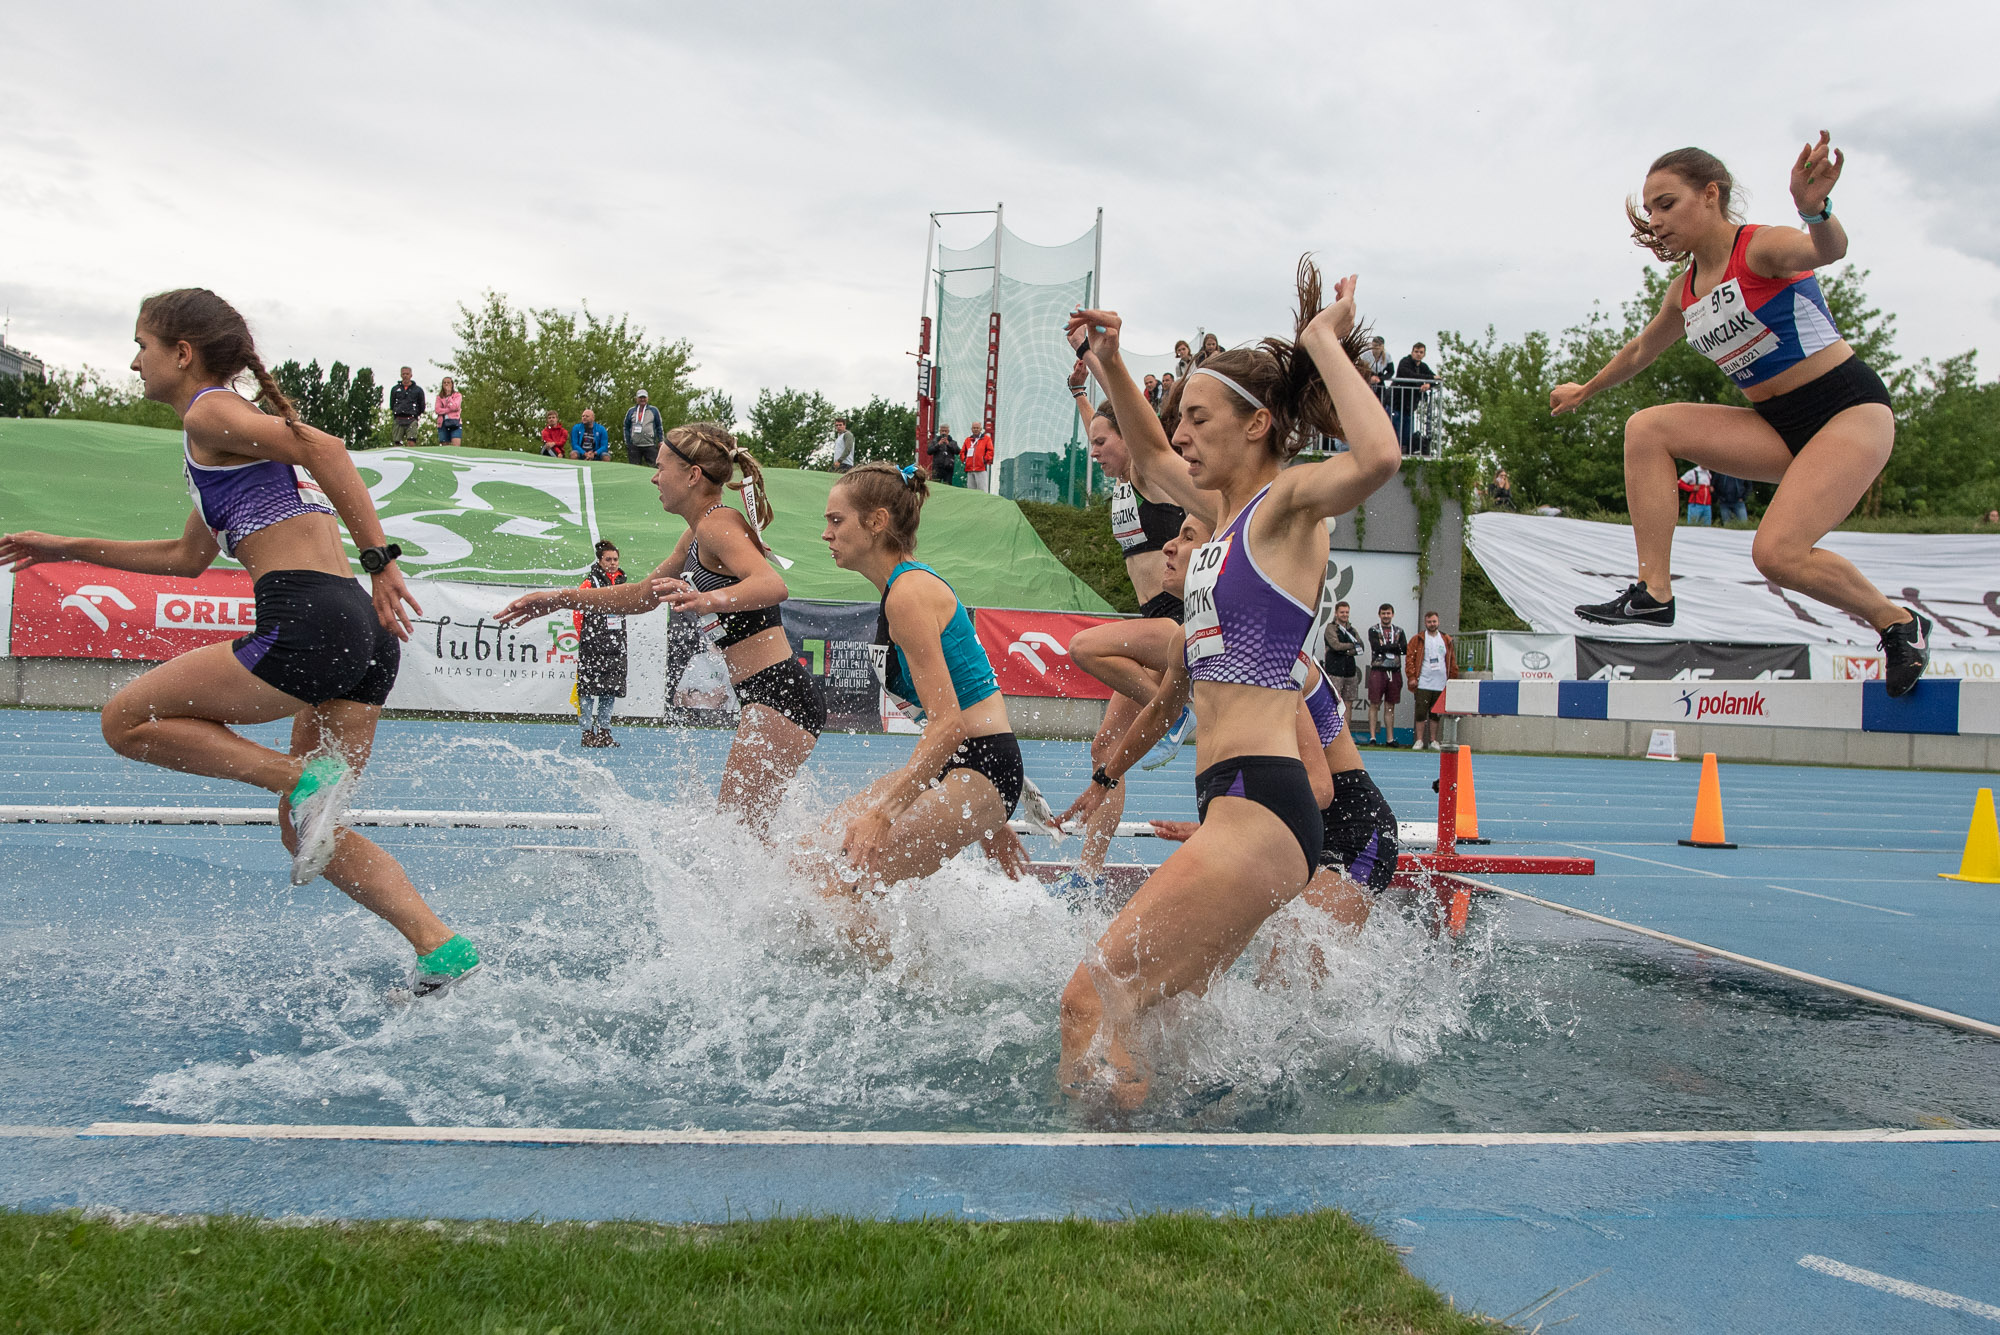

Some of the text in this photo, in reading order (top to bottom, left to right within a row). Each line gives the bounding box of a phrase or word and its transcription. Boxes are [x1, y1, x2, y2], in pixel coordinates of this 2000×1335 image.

[1690, 311, 1755, 355] KLIMCZAK
[1722, 348, 1761, 375] BLIN 2021
[1193, 546, 1222, 575] 10
[163, 599, 257, 625] ORLE
[434, 615, 538, 663] lublin
[434, 666, 576, 680] MIASTO INSPIRAC
[1519, 670, 1553, 680] TOYOTA
[1962, 661, 1995, 679] 100
[1697, 690, 1766, 720] polanik
